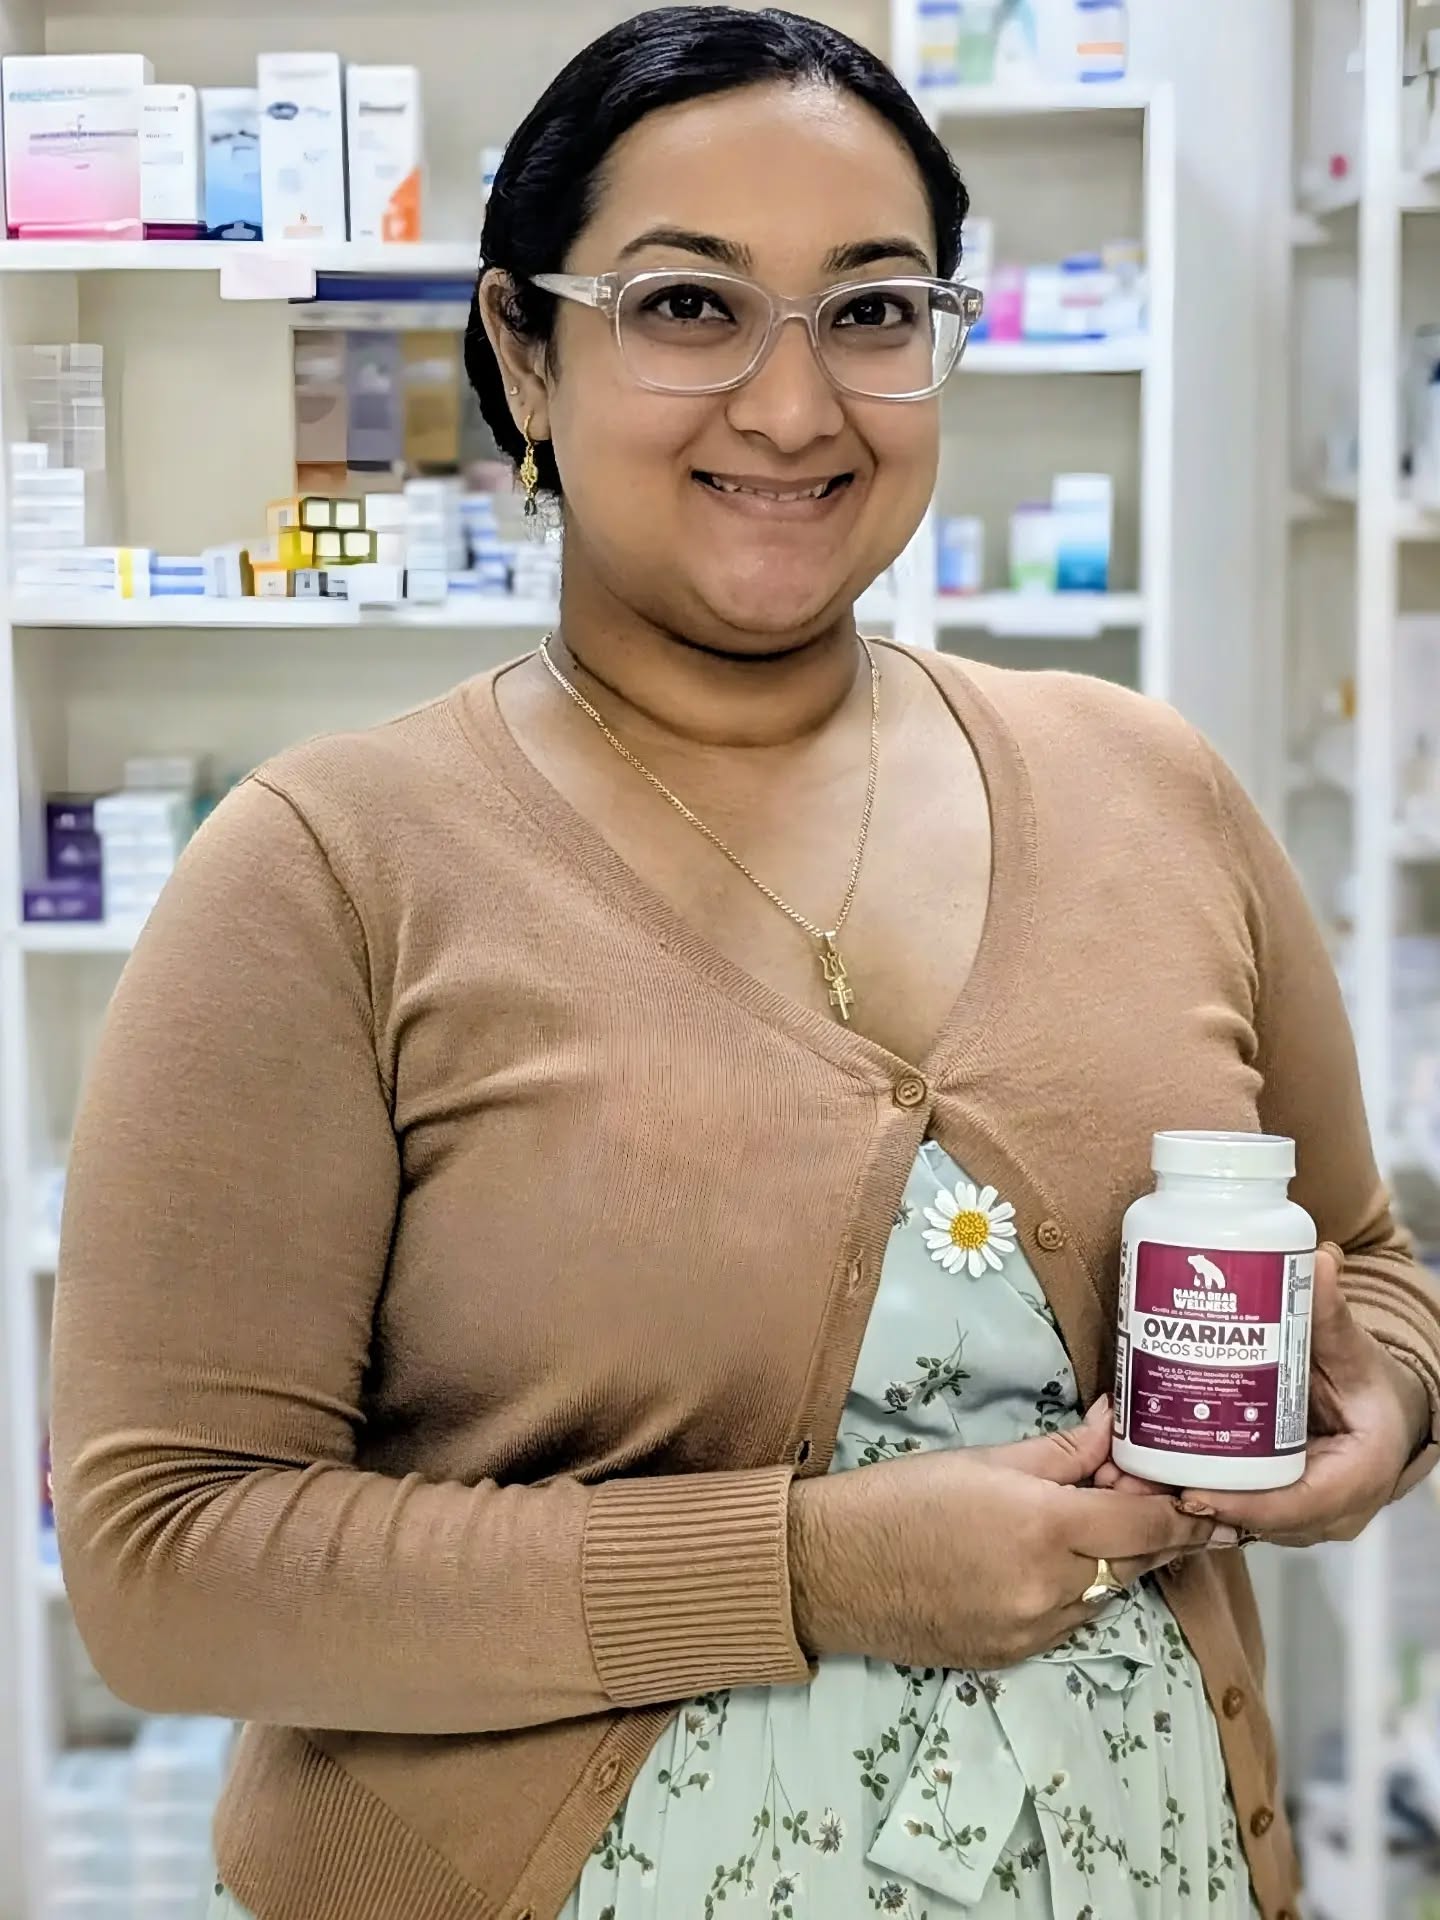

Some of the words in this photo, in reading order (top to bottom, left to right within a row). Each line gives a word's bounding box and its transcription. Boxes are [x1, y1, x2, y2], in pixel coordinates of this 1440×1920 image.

[1173, 1298, 1237, 1313] WELLNESS
[1143, 1317, 1265, 1346] OVARIAN
[1141, 1338, 1149, 1350] &
[1151, 1340, 1190, 1356] PCOS
[1194, 1345, 1267, 1360] SUPPORT
[1215, 1430, 1230, 1442] 120
